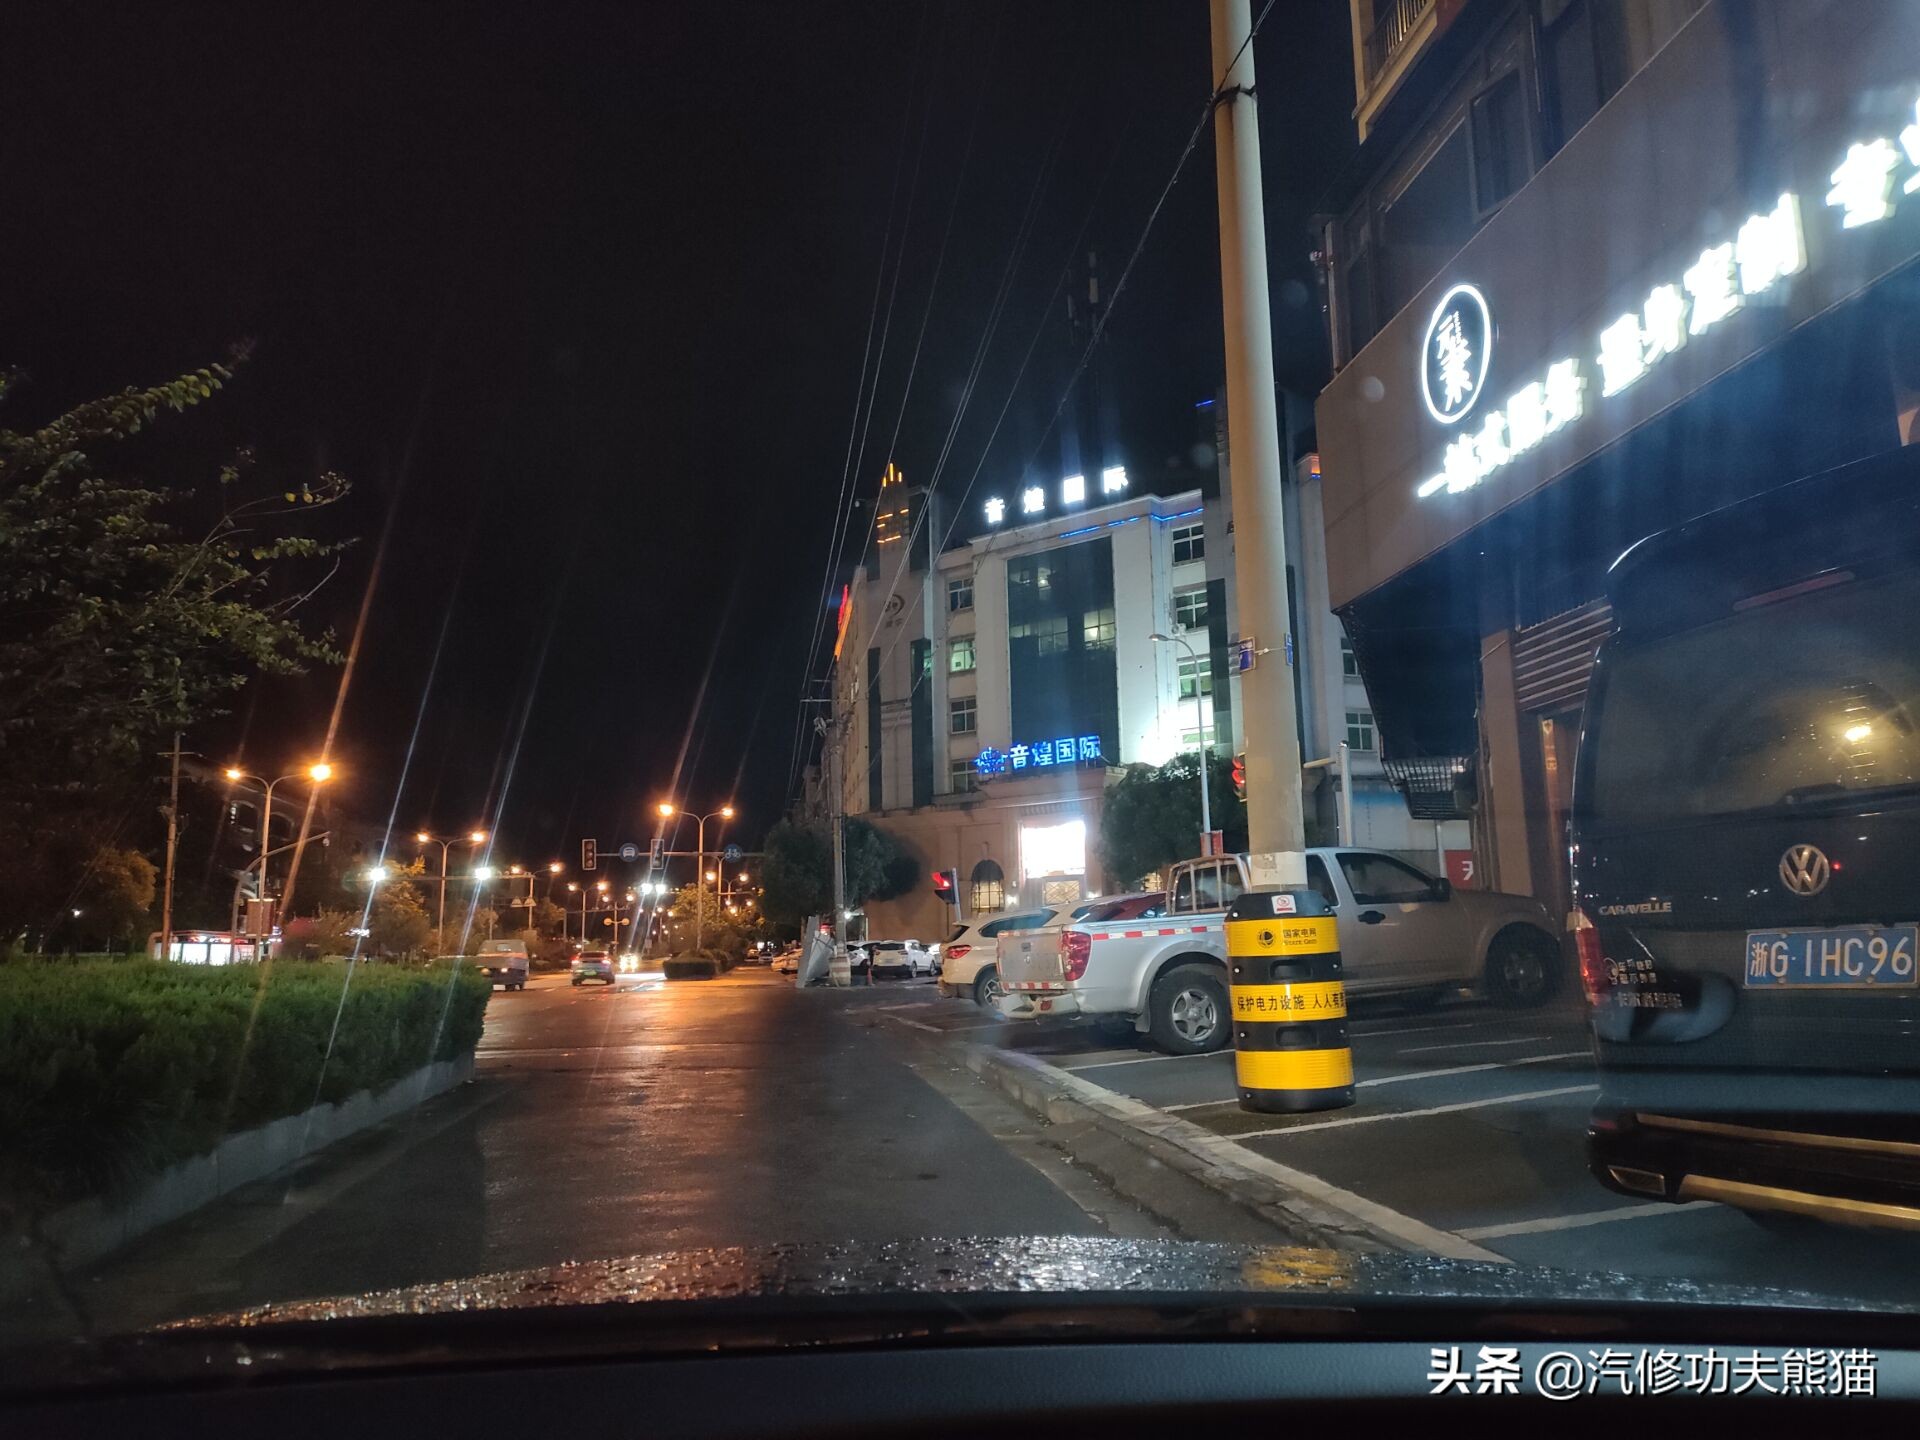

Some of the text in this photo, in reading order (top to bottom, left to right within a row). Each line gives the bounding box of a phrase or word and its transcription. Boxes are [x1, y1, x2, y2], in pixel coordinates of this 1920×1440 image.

[984, 466, 1129, 524] 音煌国际
[1009, 736, 1102, 769] 音煌国际
[1598, 902, 1672, 916] CARAVELLE
[1283, 928, 1317, 938] 国家电网
[1237, 994, 1305, 1012] 保护电力设施
